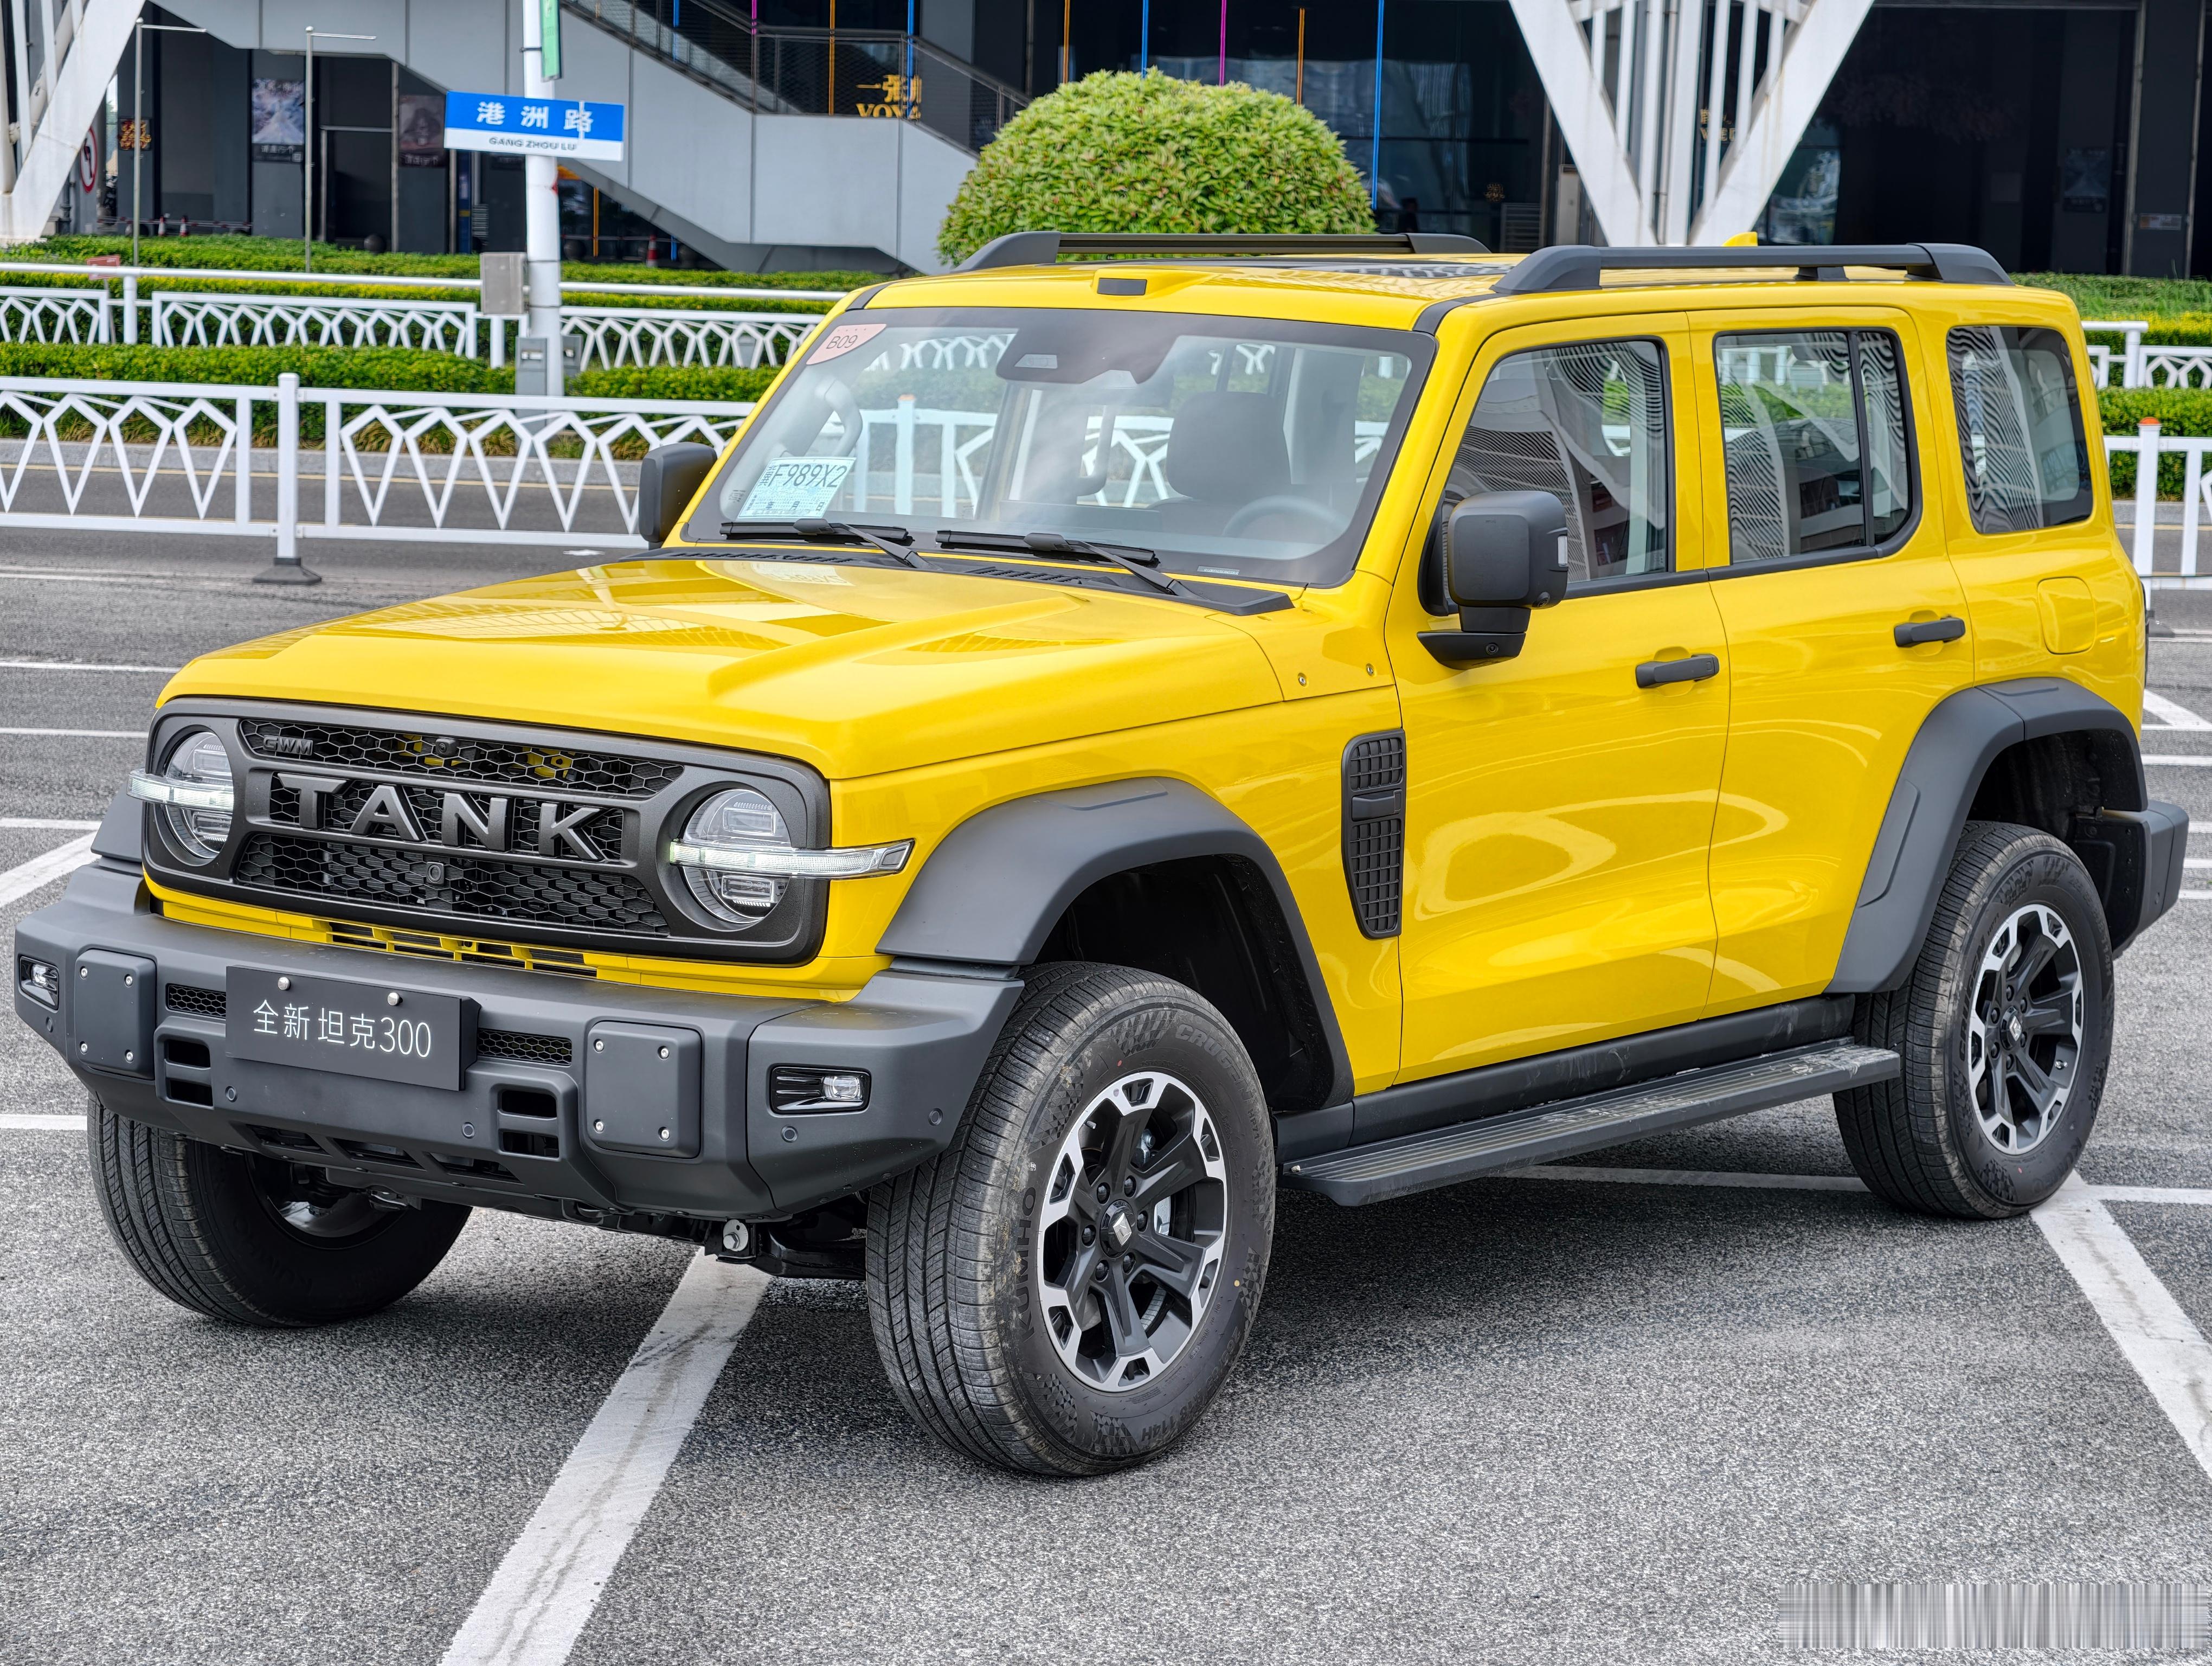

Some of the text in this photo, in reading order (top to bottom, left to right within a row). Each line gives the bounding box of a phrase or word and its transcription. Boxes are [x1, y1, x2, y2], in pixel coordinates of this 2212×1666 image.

[477, 101, 594, 133] 港洲路
[489, 137, 577, 151] GANG ZHOU LU
[826, 335, 858, 349] B09
[263, 735, 312, 755] GWM
[277, 772, 606, 862] TANK
[1175, 1023, 1255, 1102] CRUGEN
[1015, 1187, 1036, 1343] KUMHO
